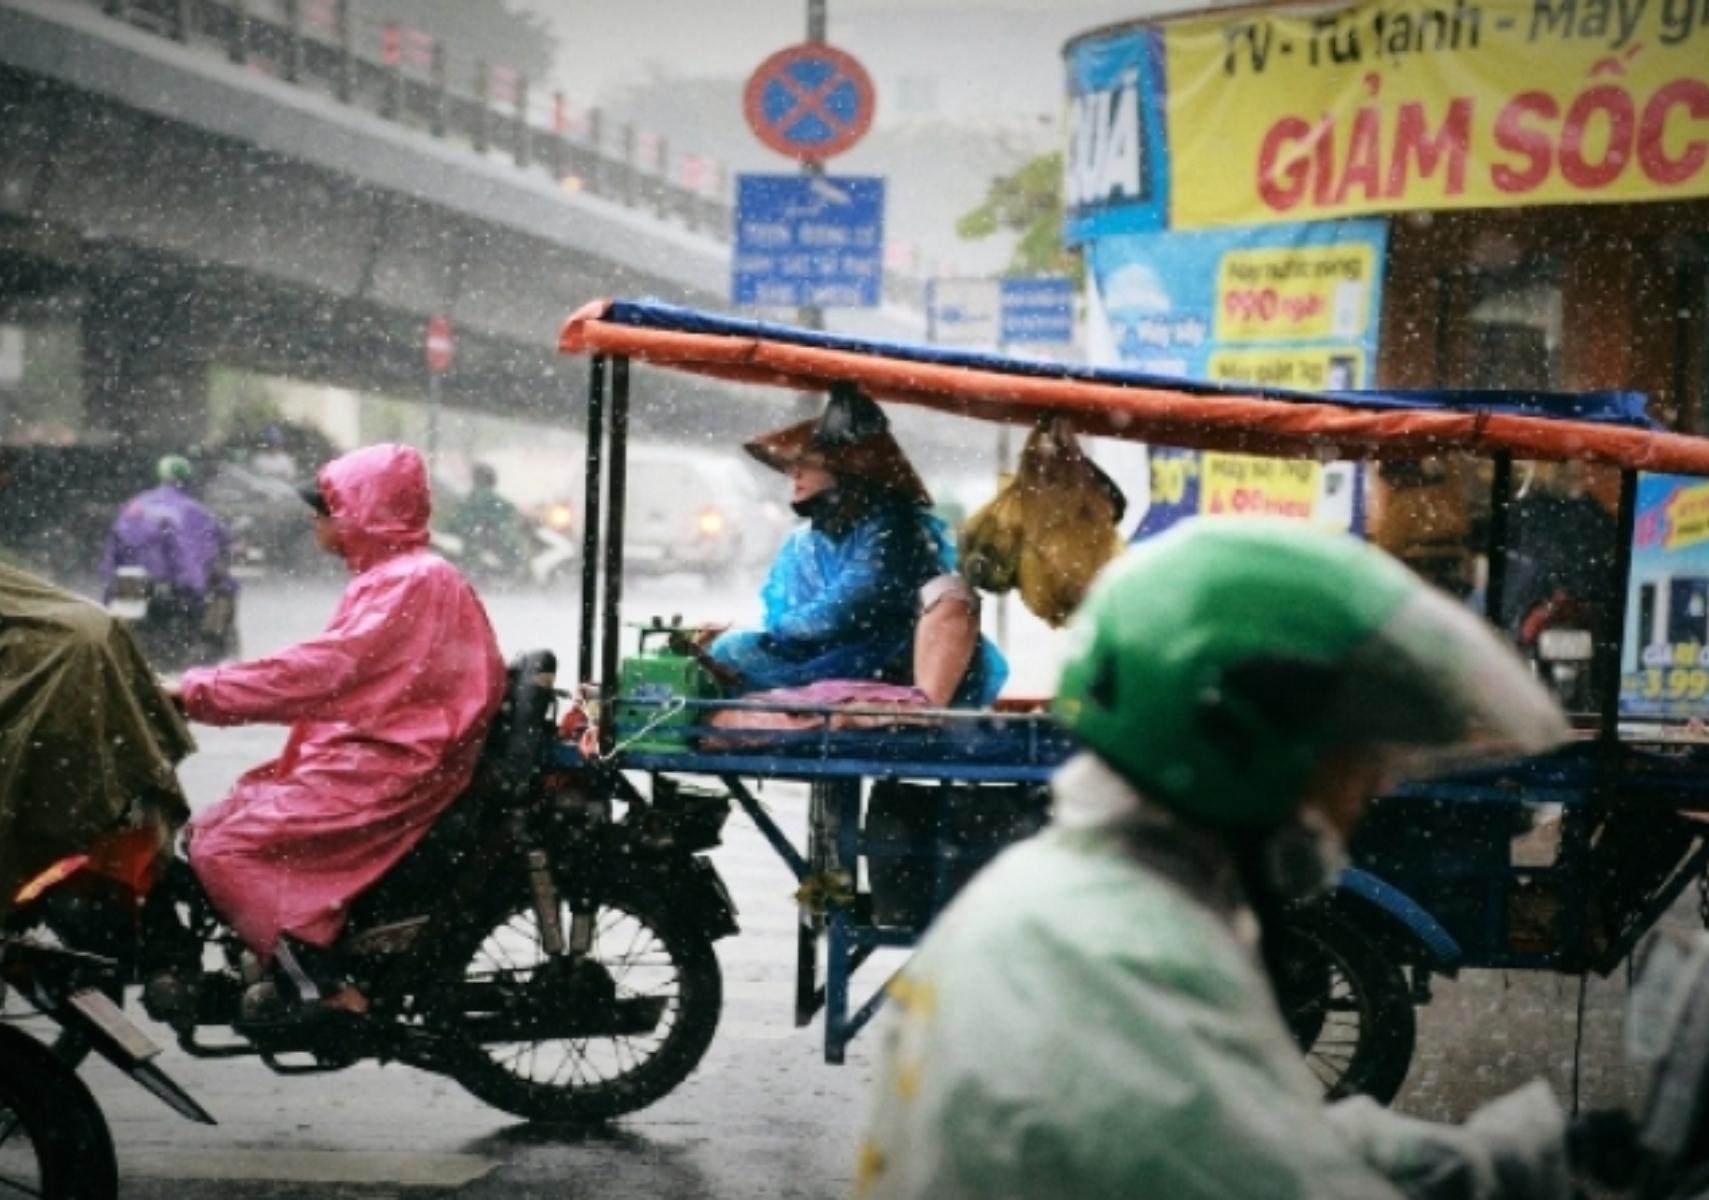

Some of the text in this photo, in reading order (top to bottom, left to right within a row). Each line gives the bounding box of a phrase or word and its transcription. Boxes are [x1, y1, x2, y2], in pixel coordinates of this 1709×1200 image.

[1223, 22, 1272, 75] TV
[1257, 42, 1709, 213] GIẢM SỐC
